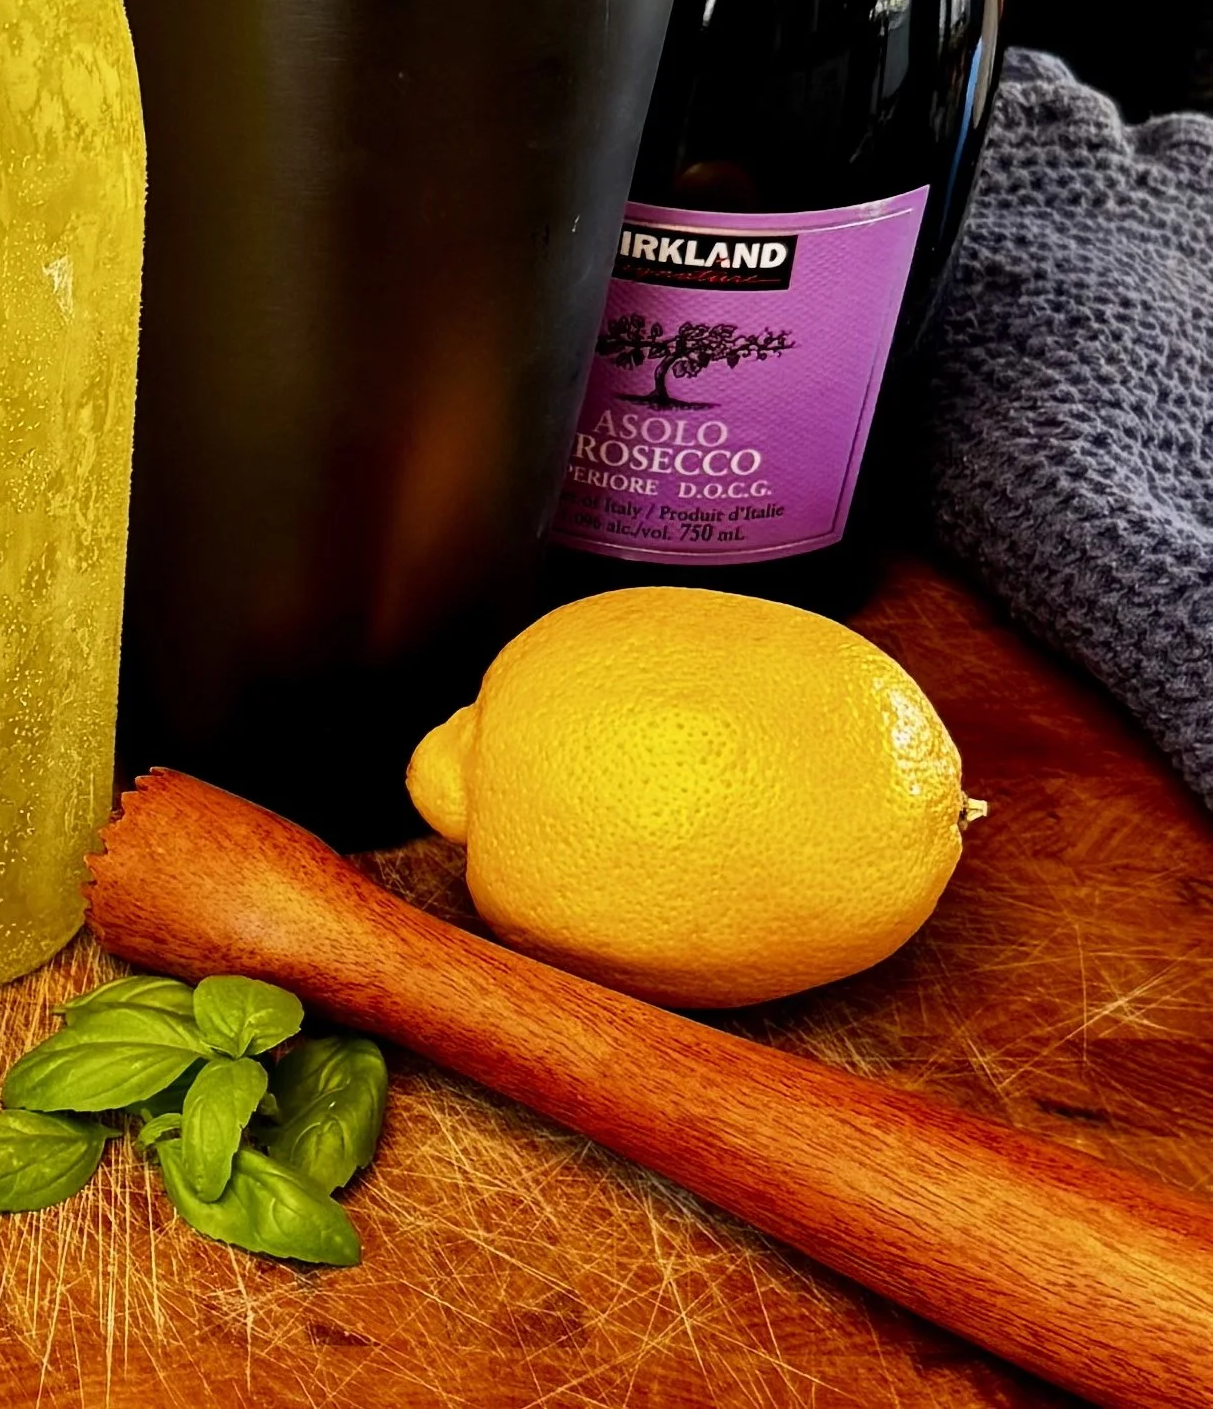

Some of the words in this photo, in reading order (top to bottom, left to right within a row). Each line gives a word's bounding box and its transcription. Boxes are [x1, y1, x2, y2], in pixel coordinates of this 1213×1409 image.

[619, 230, 789, 269] IRKLAND
[593, 408, 729, 448] ASOLO
[572, 432, 762, 477] ROSECCO
[678, 480, 773, 500] D.O.C.G.
[604, 497, 643, 521] Italy
[659, 504, 724, 523] Produit
[728, 503, 785, 521] d'Italie
[605, 517, 672, 541] alc./vol.
[679, 523, 714, 542] 750
[717, 528, 745, 541] mL
